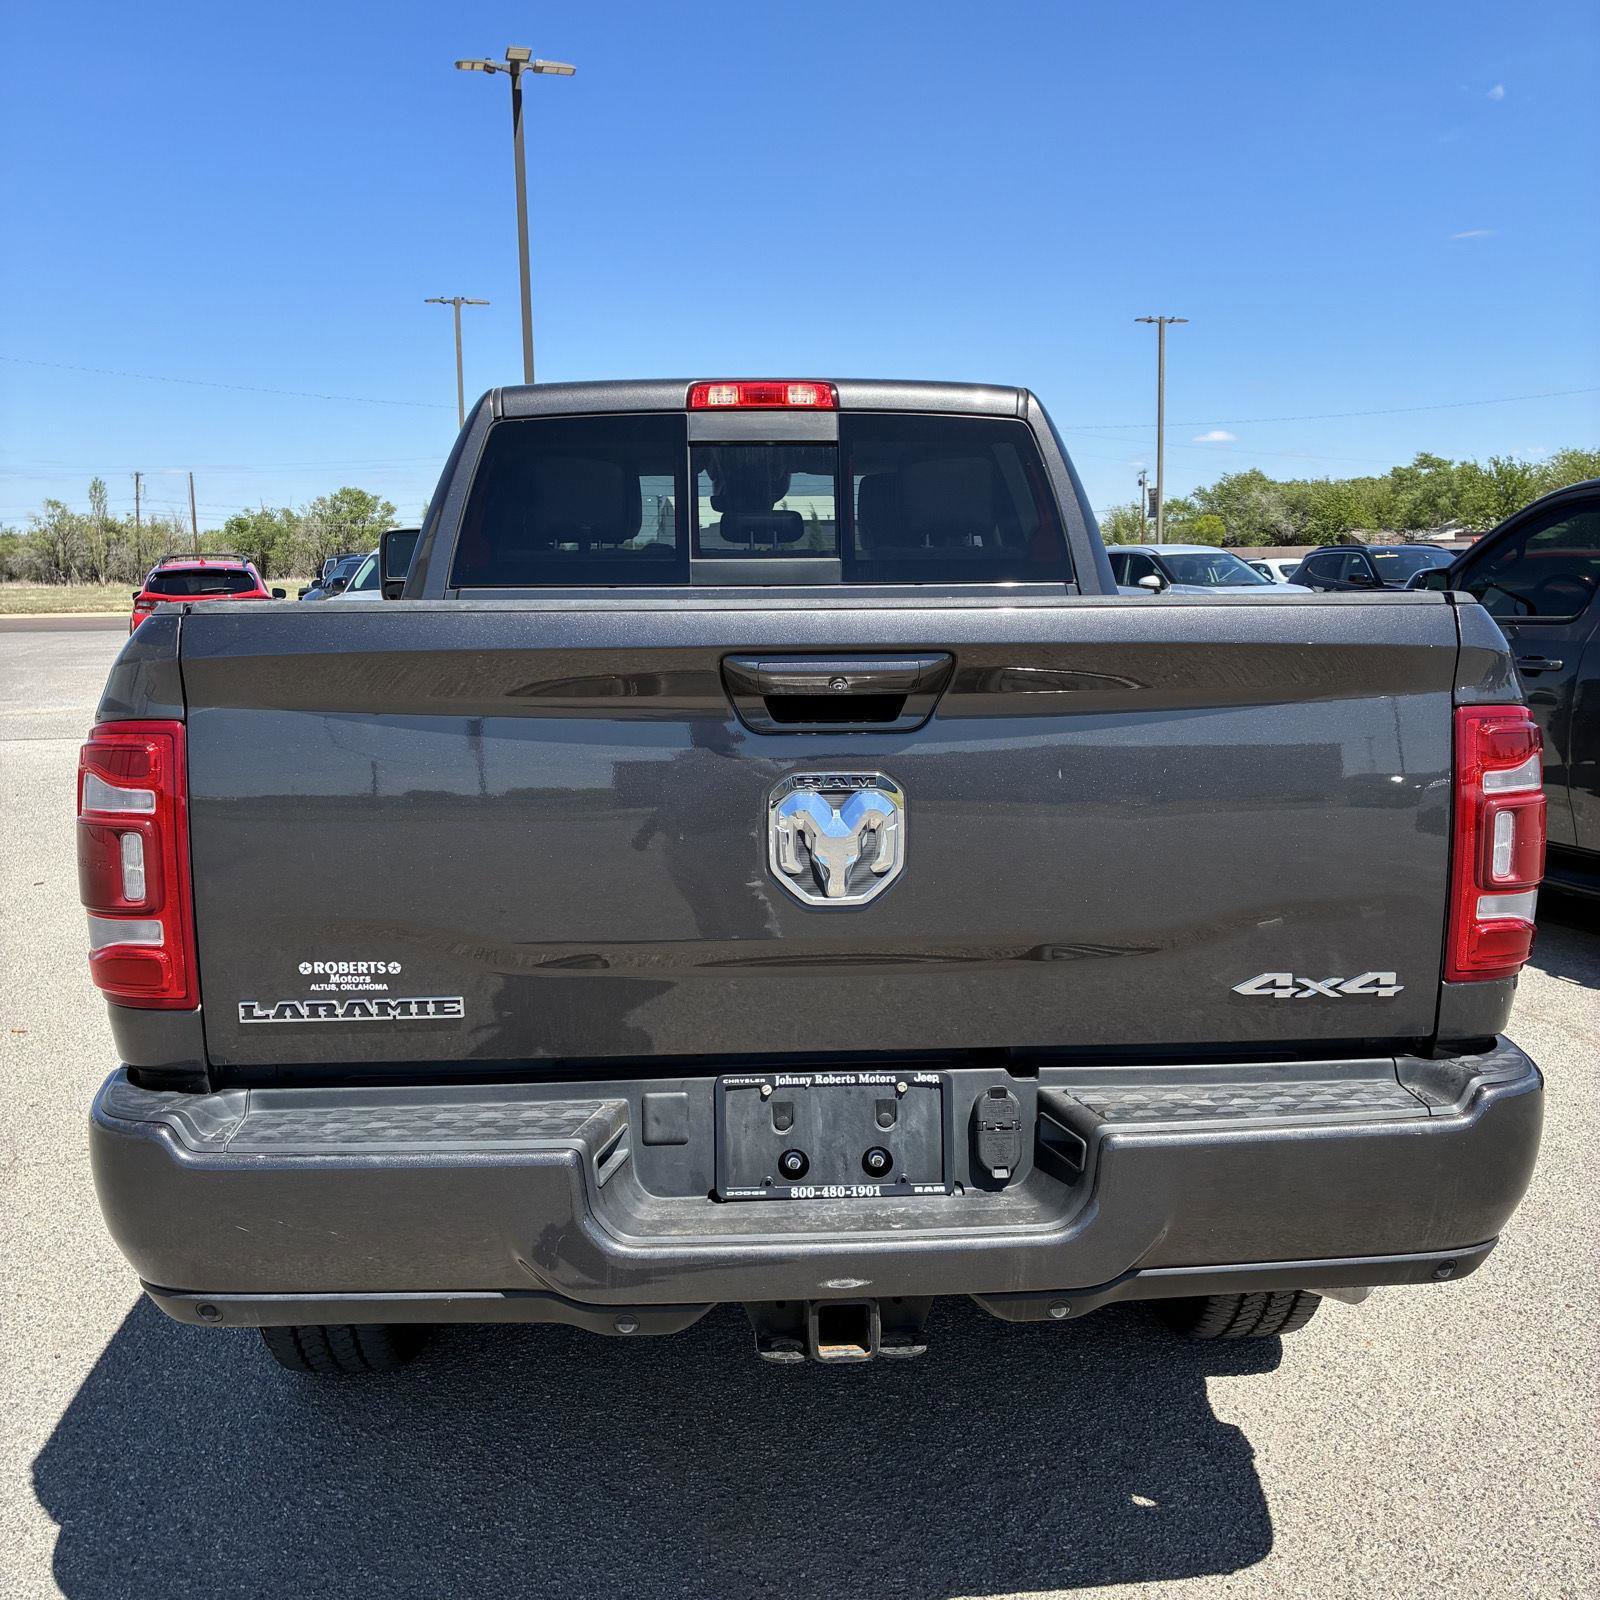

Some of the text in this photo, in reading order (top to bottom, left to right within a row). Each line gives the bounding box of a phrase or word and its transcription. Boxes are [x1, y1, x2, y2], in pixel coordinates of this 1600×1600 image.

[796, 776, 878, 788] RAM
[313, 961, 387, 974] ROBERTS
[329, 974, 371, 983] Motors
[310, 983, 388, 991] ALTUS, OKLAHOMA
[238, 996, 465, 1023] LARAMIE
[775, 1074, 897, 1087] Johnny Roberts Motors
[913, 1073, 940, 1084] Jeep
[790, 1186, 881, 1198] 800-480-1901
[914, 1185, 946, 1193] RAM
